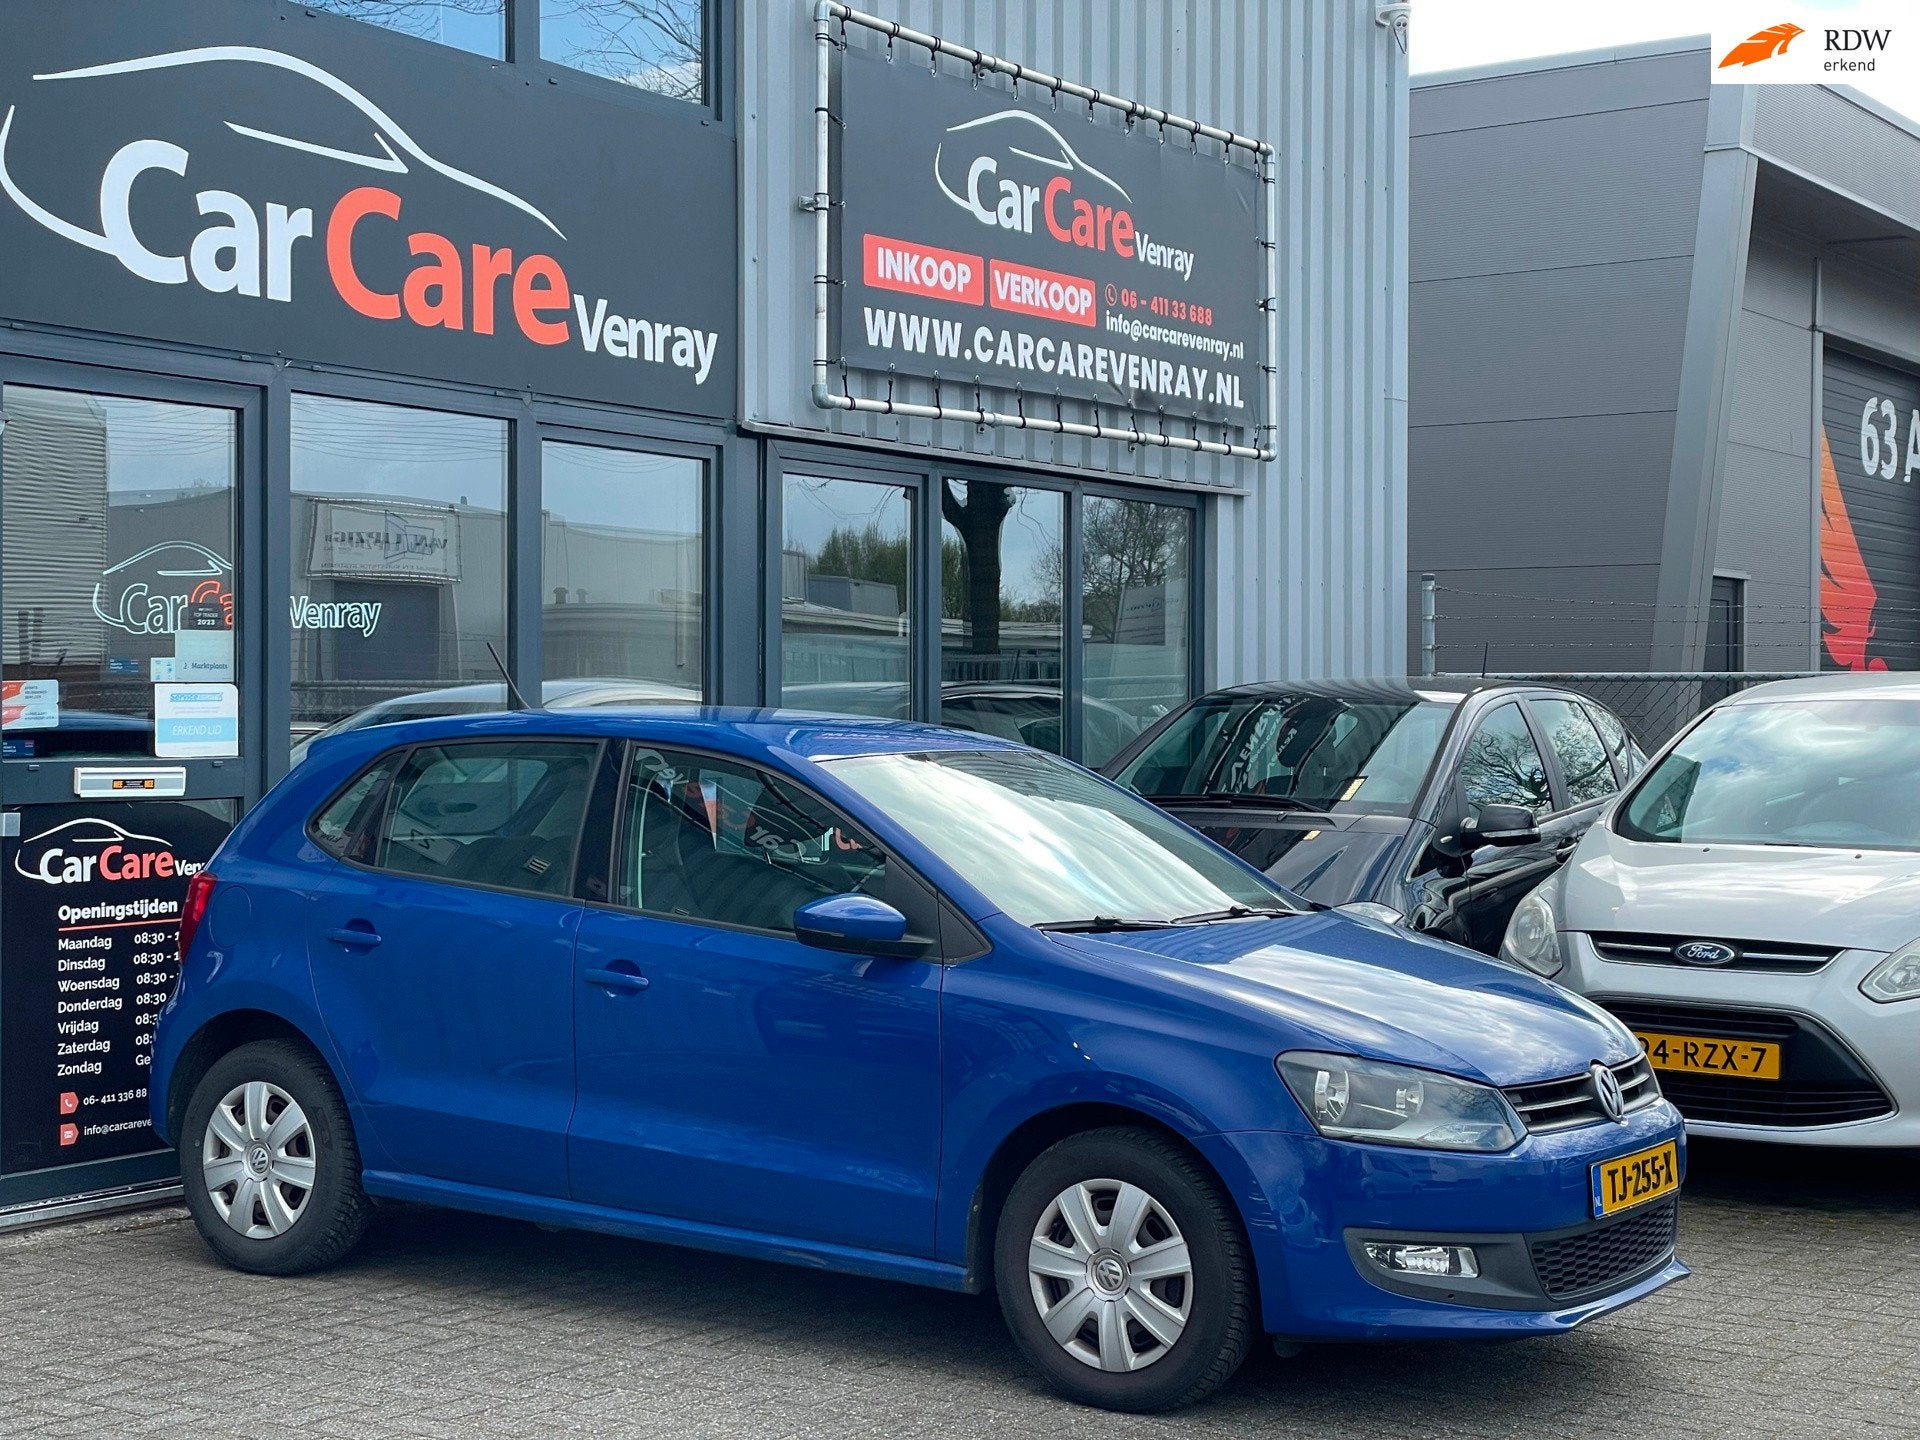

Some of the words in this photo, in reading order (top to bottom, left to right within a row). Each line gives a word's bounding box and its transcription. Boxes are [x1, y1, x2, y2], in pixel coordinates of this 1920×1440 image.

[1134, 231, 1195, 281] Venray
[876, 246, 972, 292] INKOOP
[993, 269, 1093, 317] VERKOOP
[1121, 289, 1137, 308] 06
[1151, 296, 1169, 315] 411
[1172, 301, 1186, 319] 33
[1190, 304, 1212, 325] 688
[573, 294, 718, 384] Venray
[1105, 310, 1245, 361] info@carcarevenray.nl
[863, 307, 1245, 408] WWW.CARCAREVENRAY.NL
[1861, 396, 1898, 480] 63
[289, 595, 382, 637] Venray
[172, 725, 207, 736] ERKEND
[58, 898, 178, 924] Openingstijden
[58, 936, 112, 951] Maandag
[133, 932, 165, 945] 08:30
[1687, 944, 1721, 960] Ford
[58, 957, 106, 972] Dinsdag
[133, 952, 164, 965] 08:30
[57, 977, 120, 992] Woensdag
[136, 972, 167, 985] 08:30
[57, 997, 123, 1014] Donderdag
[136, 993, 167, 1005] 08:30
[57, 1020, 99, 1035] Vrijdag
[57, 1039, 111, 1056] Zaterdag
[57, 1061, 102, 1077] Zondag
[101, 1093, 116, 1105] 411
[117, 1090, 134, 1103] 336
[135, 1088, 147, 1098] 88
[1607, 1150, 1673, 1204] TJ-255-X
